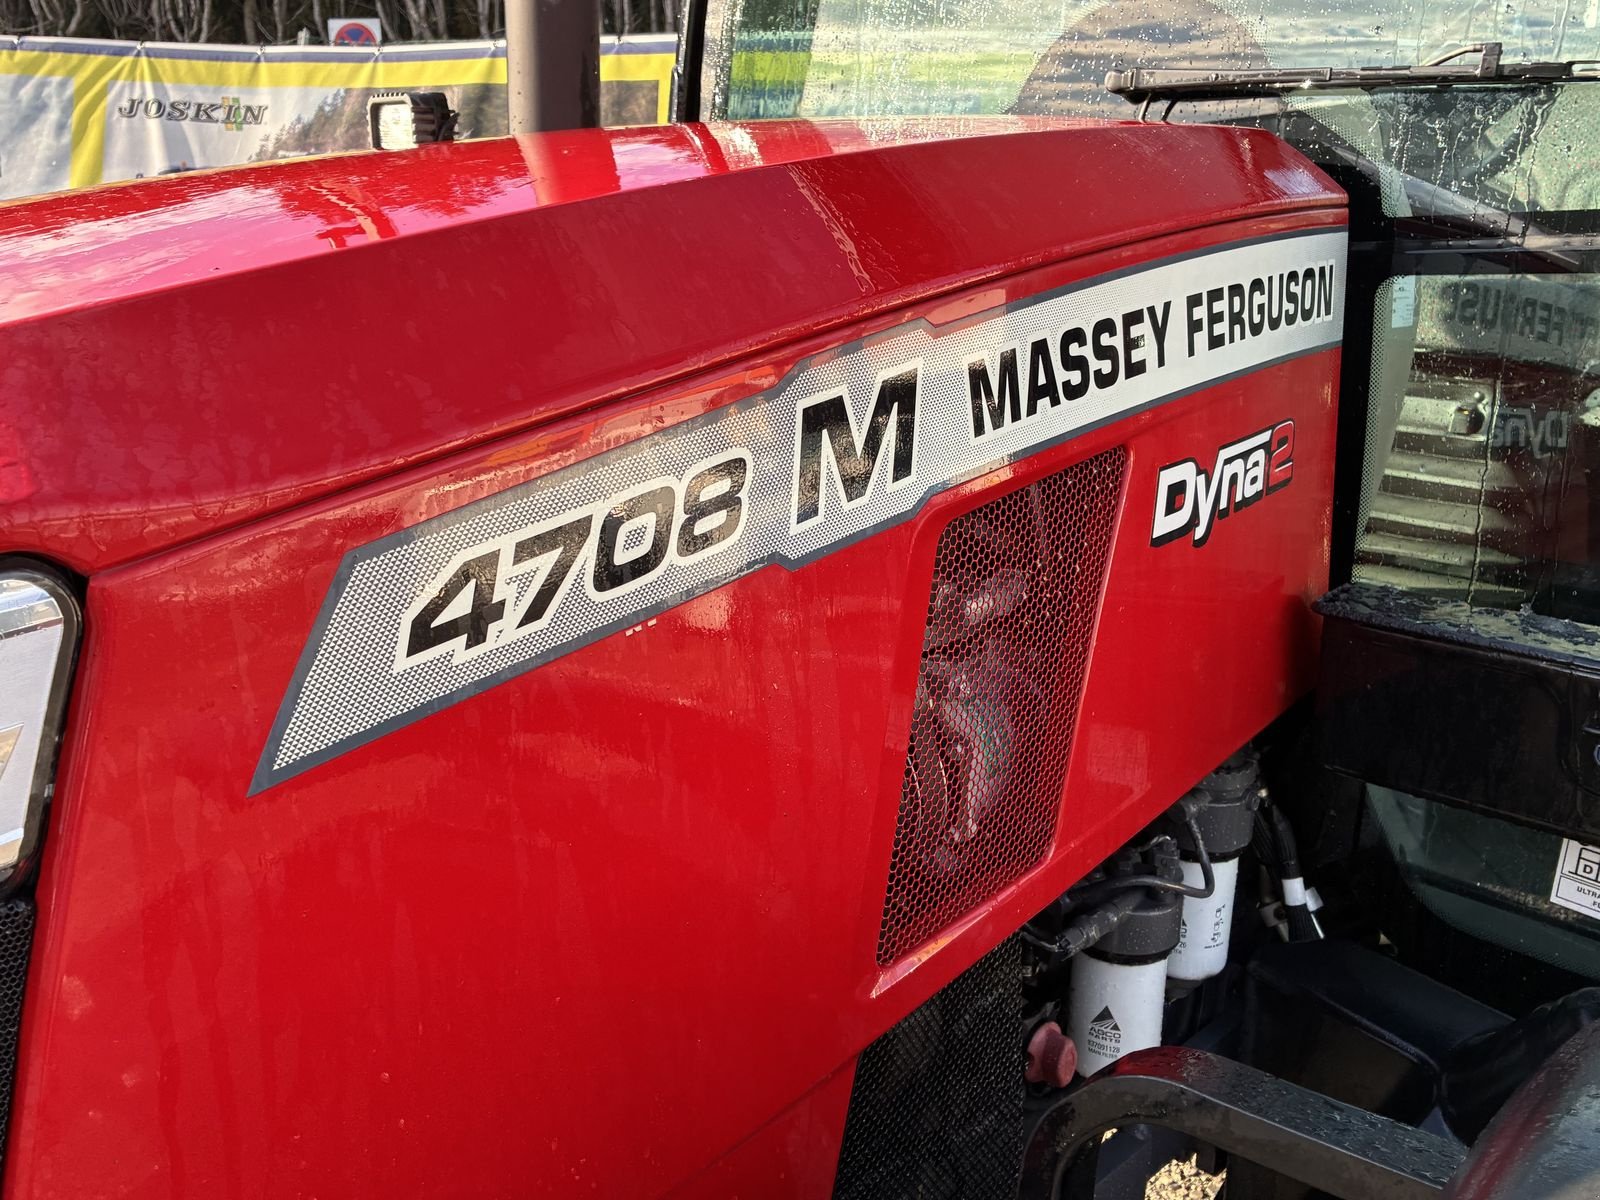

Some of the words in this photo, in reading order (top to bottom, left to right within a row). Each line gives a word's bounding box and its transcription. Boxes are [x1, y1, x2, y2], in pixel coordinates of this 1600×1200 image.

[118, 98, 268, 126] JOSKIN
[967, 300, 1172, 439] MASSEY
[1186, 264, 1334, 359] FERGUSON
[795, 365, 919, 528] M
[402, 454, 750, 662] 4708
